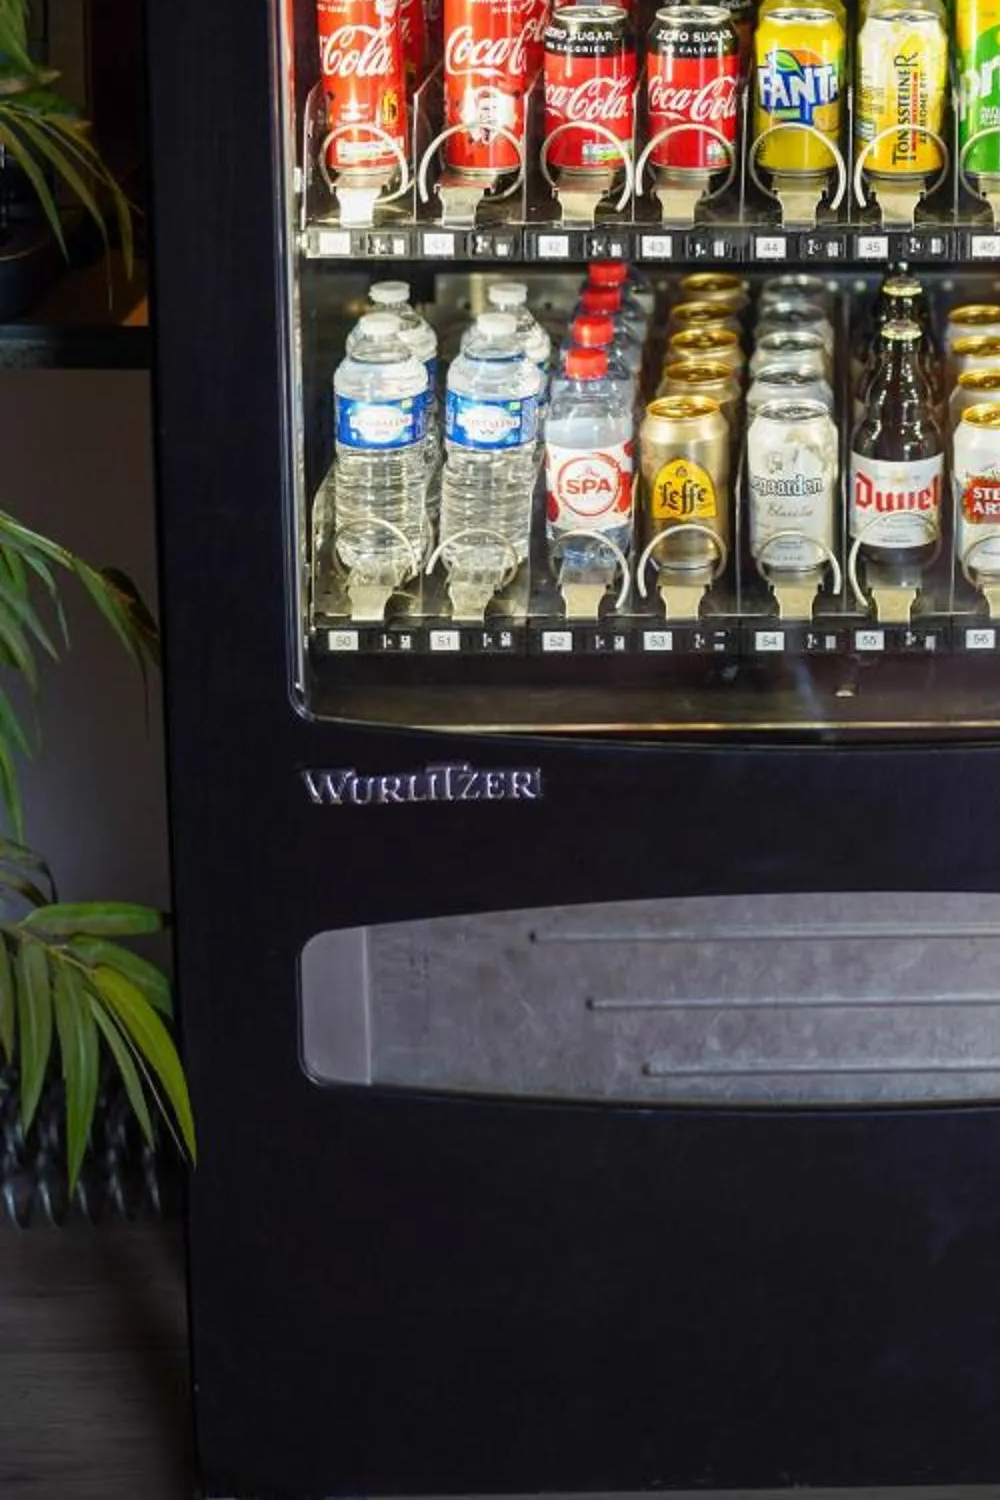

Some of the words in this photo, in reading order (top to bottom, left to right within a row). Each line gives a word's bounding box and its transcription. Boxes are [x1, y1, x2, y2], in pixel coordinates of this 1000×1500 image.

[568, 30, 614, 42] SUGAR
[656, 29, 689, 41] ZERO
[692, 29, 734, 43] SUGAR
[565, 477, 612, 495] SPA
[657, 479, 708, 515] Leffe
[855, 470, 940, 513] Duvel
[302, 762, 542, 806] WURLITZER
